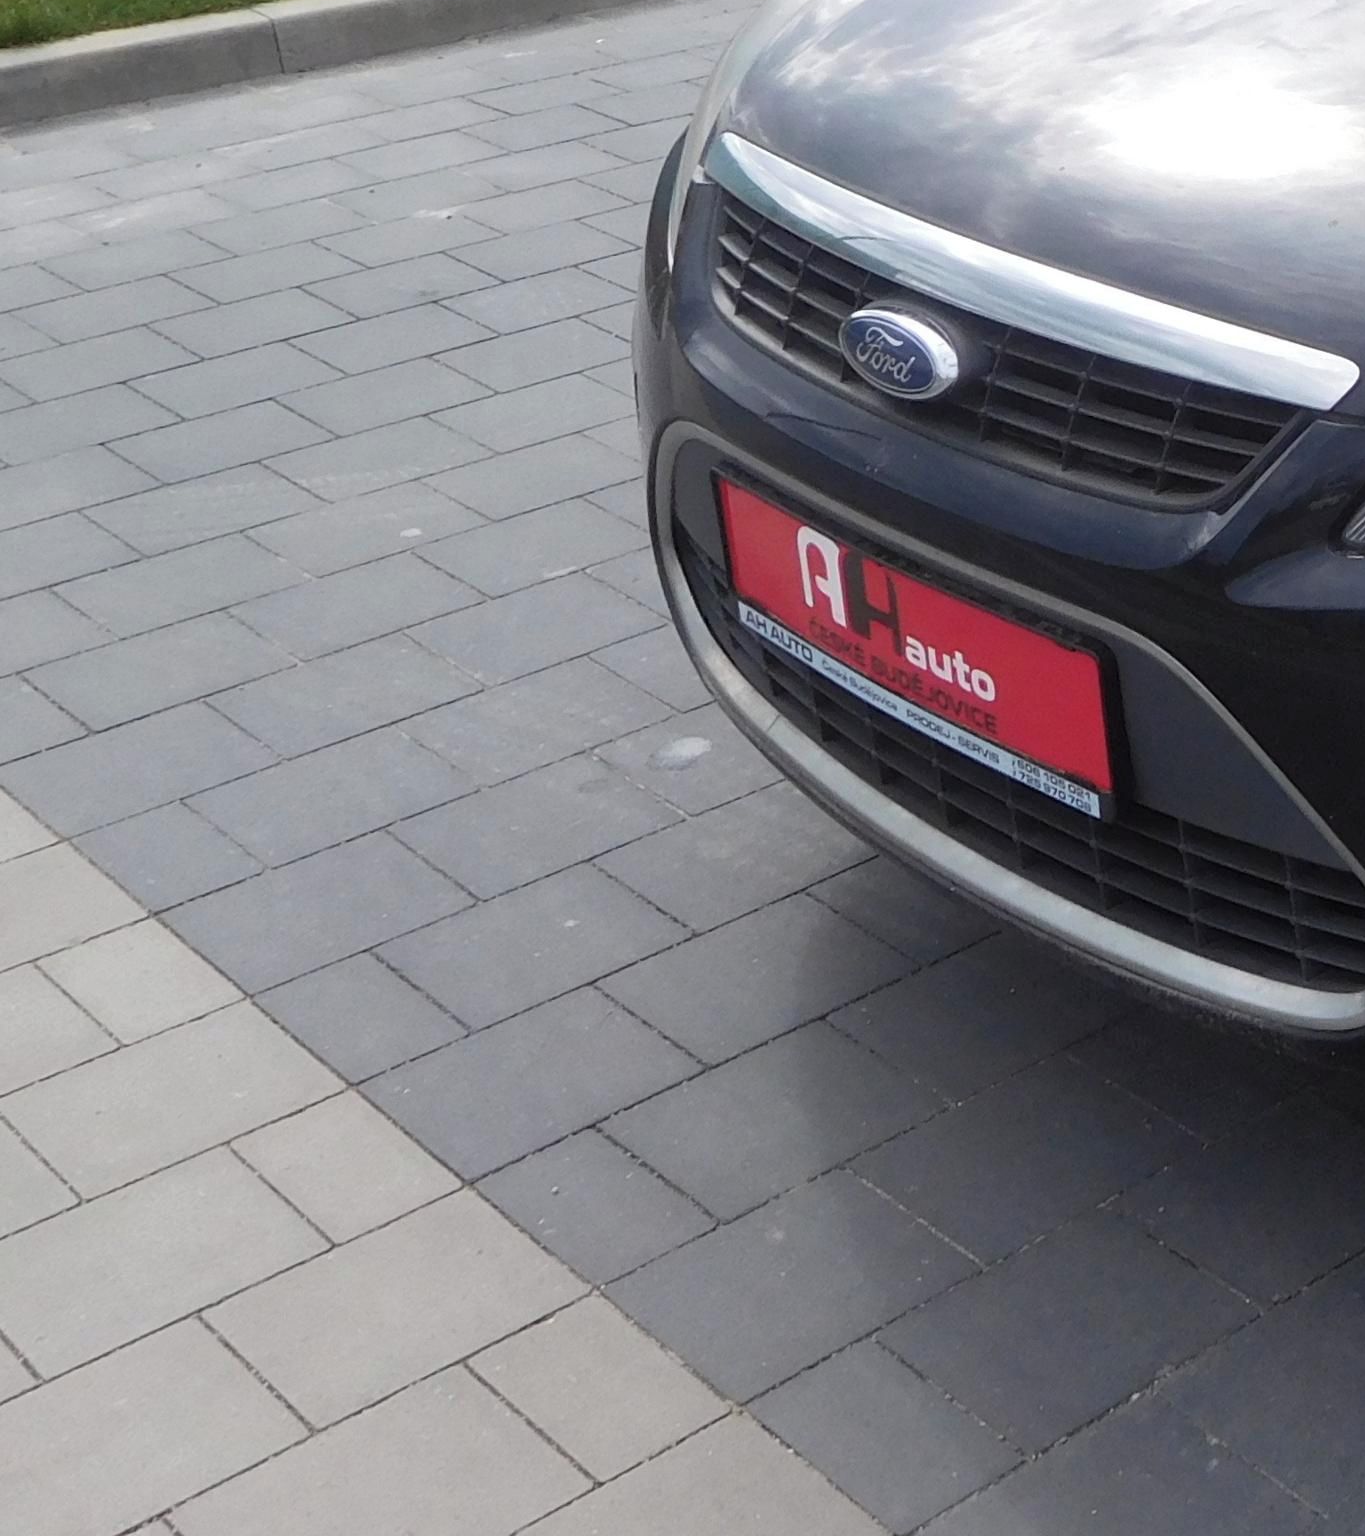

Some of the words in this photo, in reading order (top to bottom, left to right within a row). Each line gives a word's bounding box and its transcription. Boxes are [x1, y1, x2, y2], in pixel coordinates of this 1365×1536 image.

[856, 326, 916, 383] Ford
[746, 610, 767, 634] AH
[770, 625, 813, 662] AUTO
